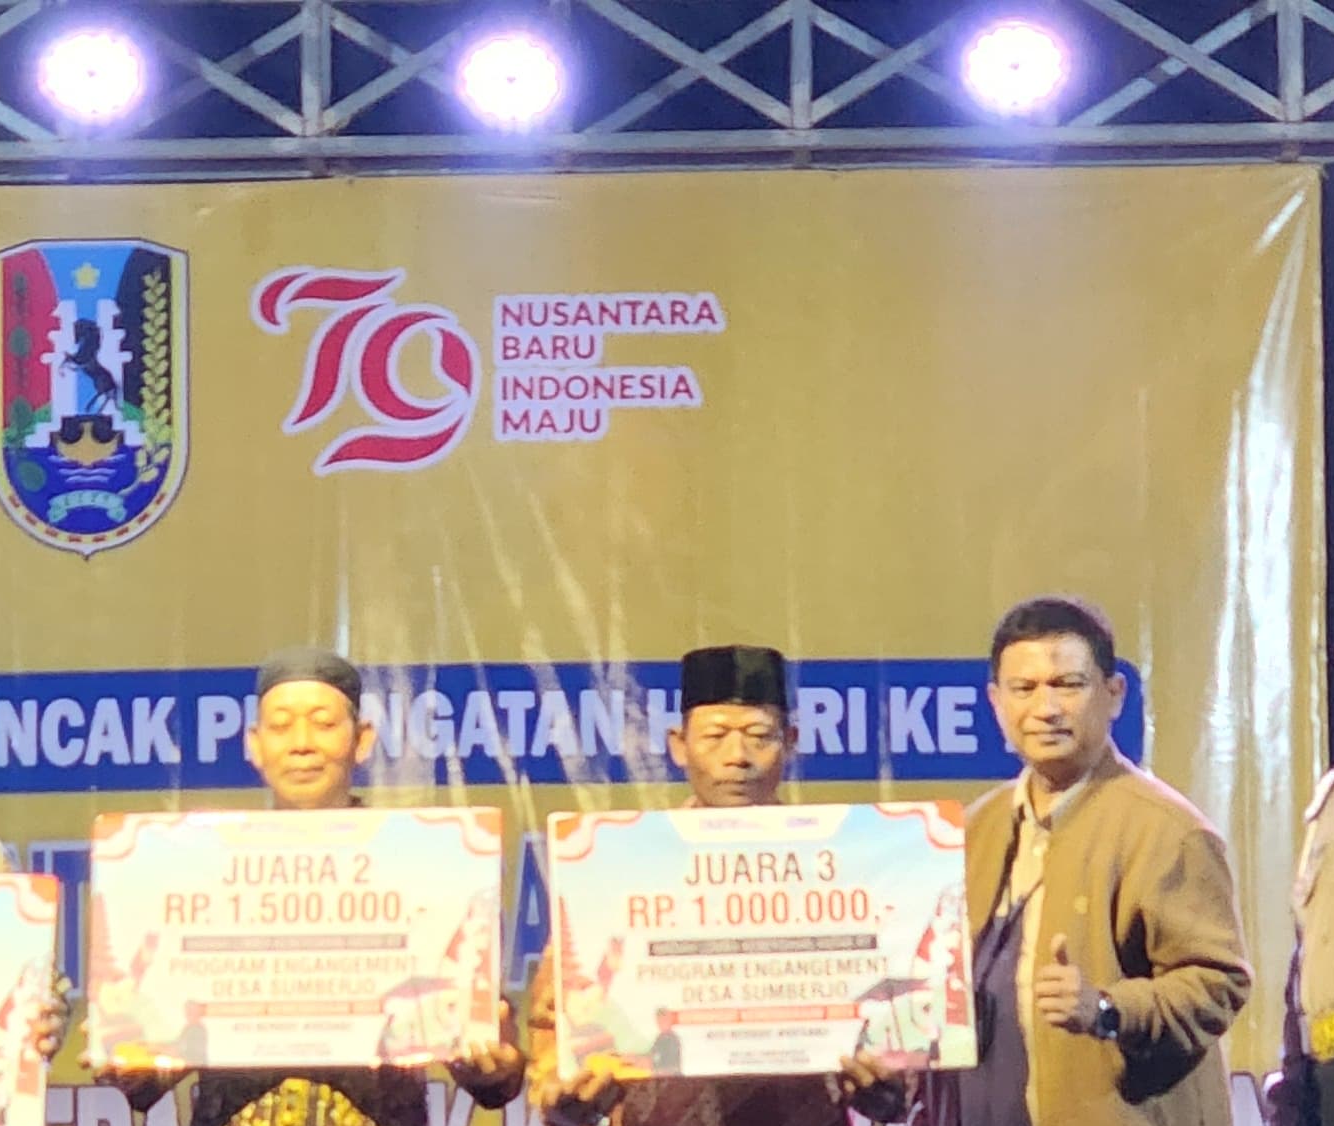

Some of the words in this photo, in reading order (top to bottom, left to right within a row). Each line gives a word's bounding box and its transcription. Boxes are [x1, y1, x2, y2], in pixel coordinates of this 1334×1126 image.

[500, 299, 718, 330] NUSANTARA
[500, 333, 597, 361] BARU
[259, 272, 473, 466] 79
[500, 373, 695, 403] INDONESIA
[500, 407, 604, 437] MAJU
[197, 689, 626, 763] PNGATAN
[647, 686, 866, 755] HRI
[889, 686, 979, 754] KE
[222, 854, 338, 887] JUARA
[353, 854, 371, 884] 2
[685, 850, 803, 886] JUARA
[818, 850, 836, 881] 3
[164, 894, 211, 925] RP.
[231, 892, 427, 925] 1.500.000,-
[628, 896, 676, 928] RP.
[695, 889, 895, 926] 1.000.000,-
[170, 957, 266, 977] PROGRAM
[637, 960, 735, 981] PROGRAM
[743, 956, 890, 977] ENGANGEMENT
[211, 980, 262, 998] DESA
[682, 984, 731, 1004] DESA
[741, 981, 848, 1001] SUMBERJO
